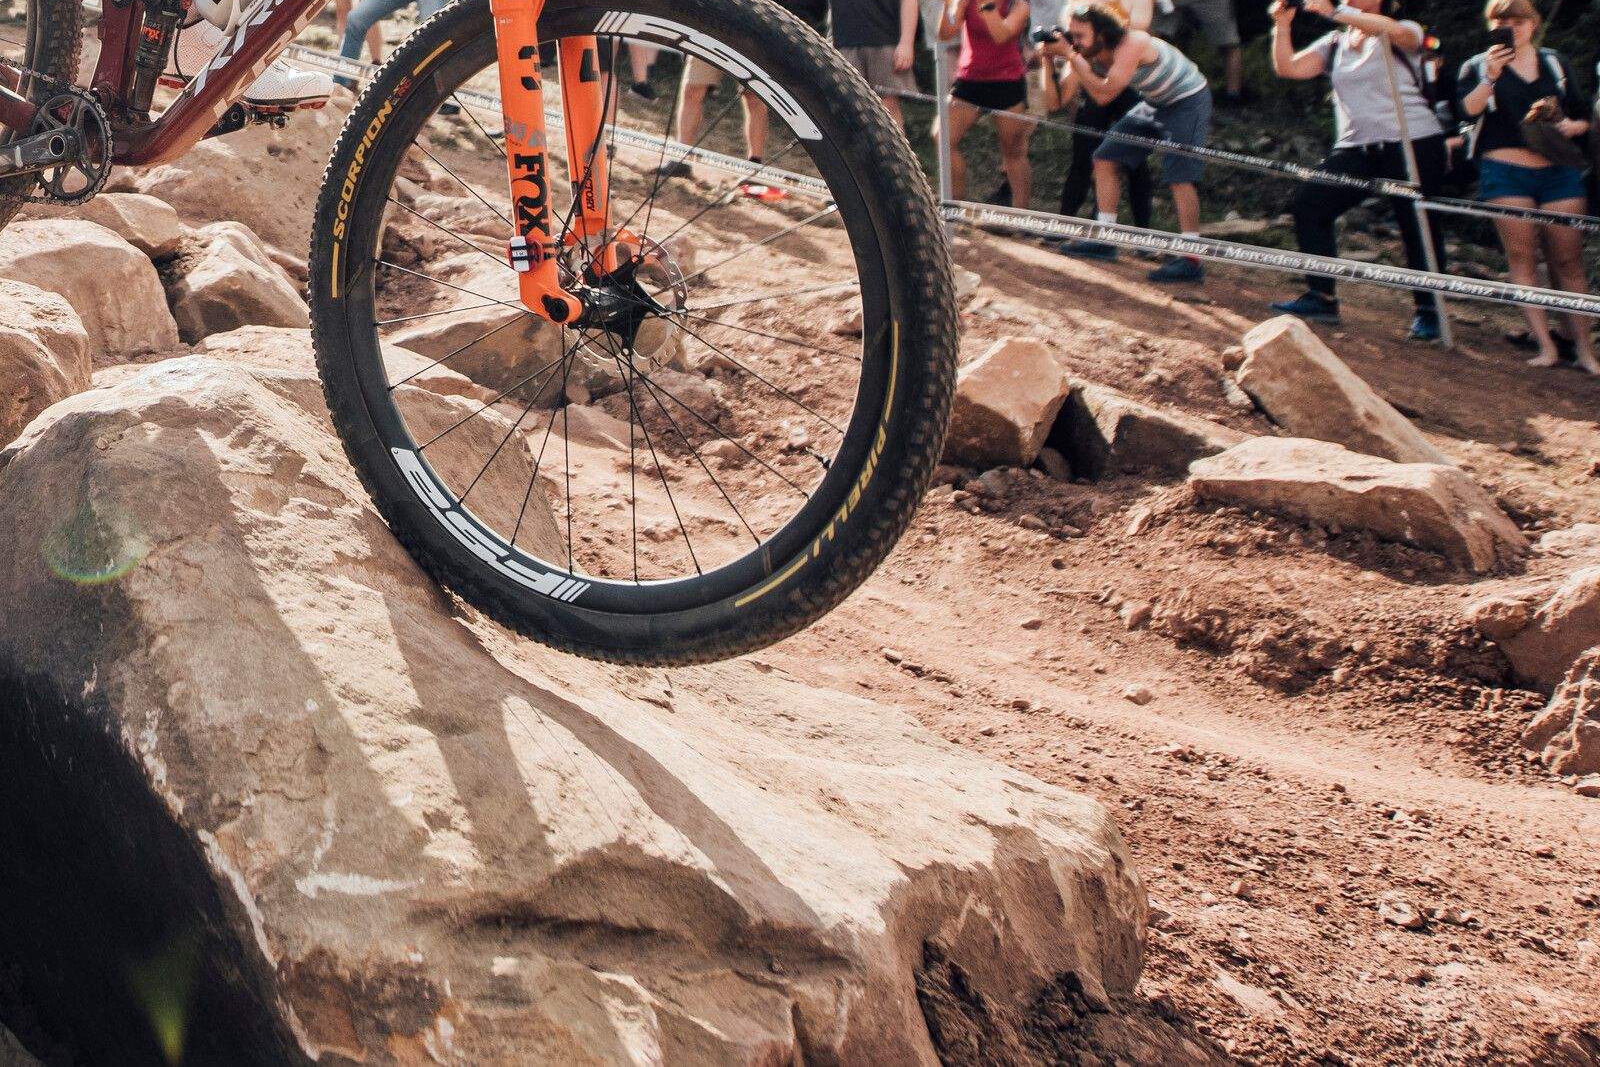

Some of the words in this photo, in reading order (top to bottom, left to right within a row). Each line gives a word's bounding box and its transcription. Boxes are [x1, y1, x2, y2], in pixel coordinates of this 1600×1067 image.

[605, 11, 823, 141] FSA
[333, 99, 393, 240] SCORPION
[513, 152, 550, 236] FOX
[980, 207, 1045, 232] Mercedes
[1047, 218, 1084, 236] Benz
[1097, 225, 1167, 249] Mercedes
[1170, 237, 1209, 256] Benz
[1224, 245, 1301, 269] Mercedes
[1303, 256, 1346, 275] Benz
[1362, 265, 1446, 290] Mercedes
[1450, 279, 1495, 297] Benz
[391, 447, 580, 599] FSA
[812, 424, 887, 558] PIRELLI
